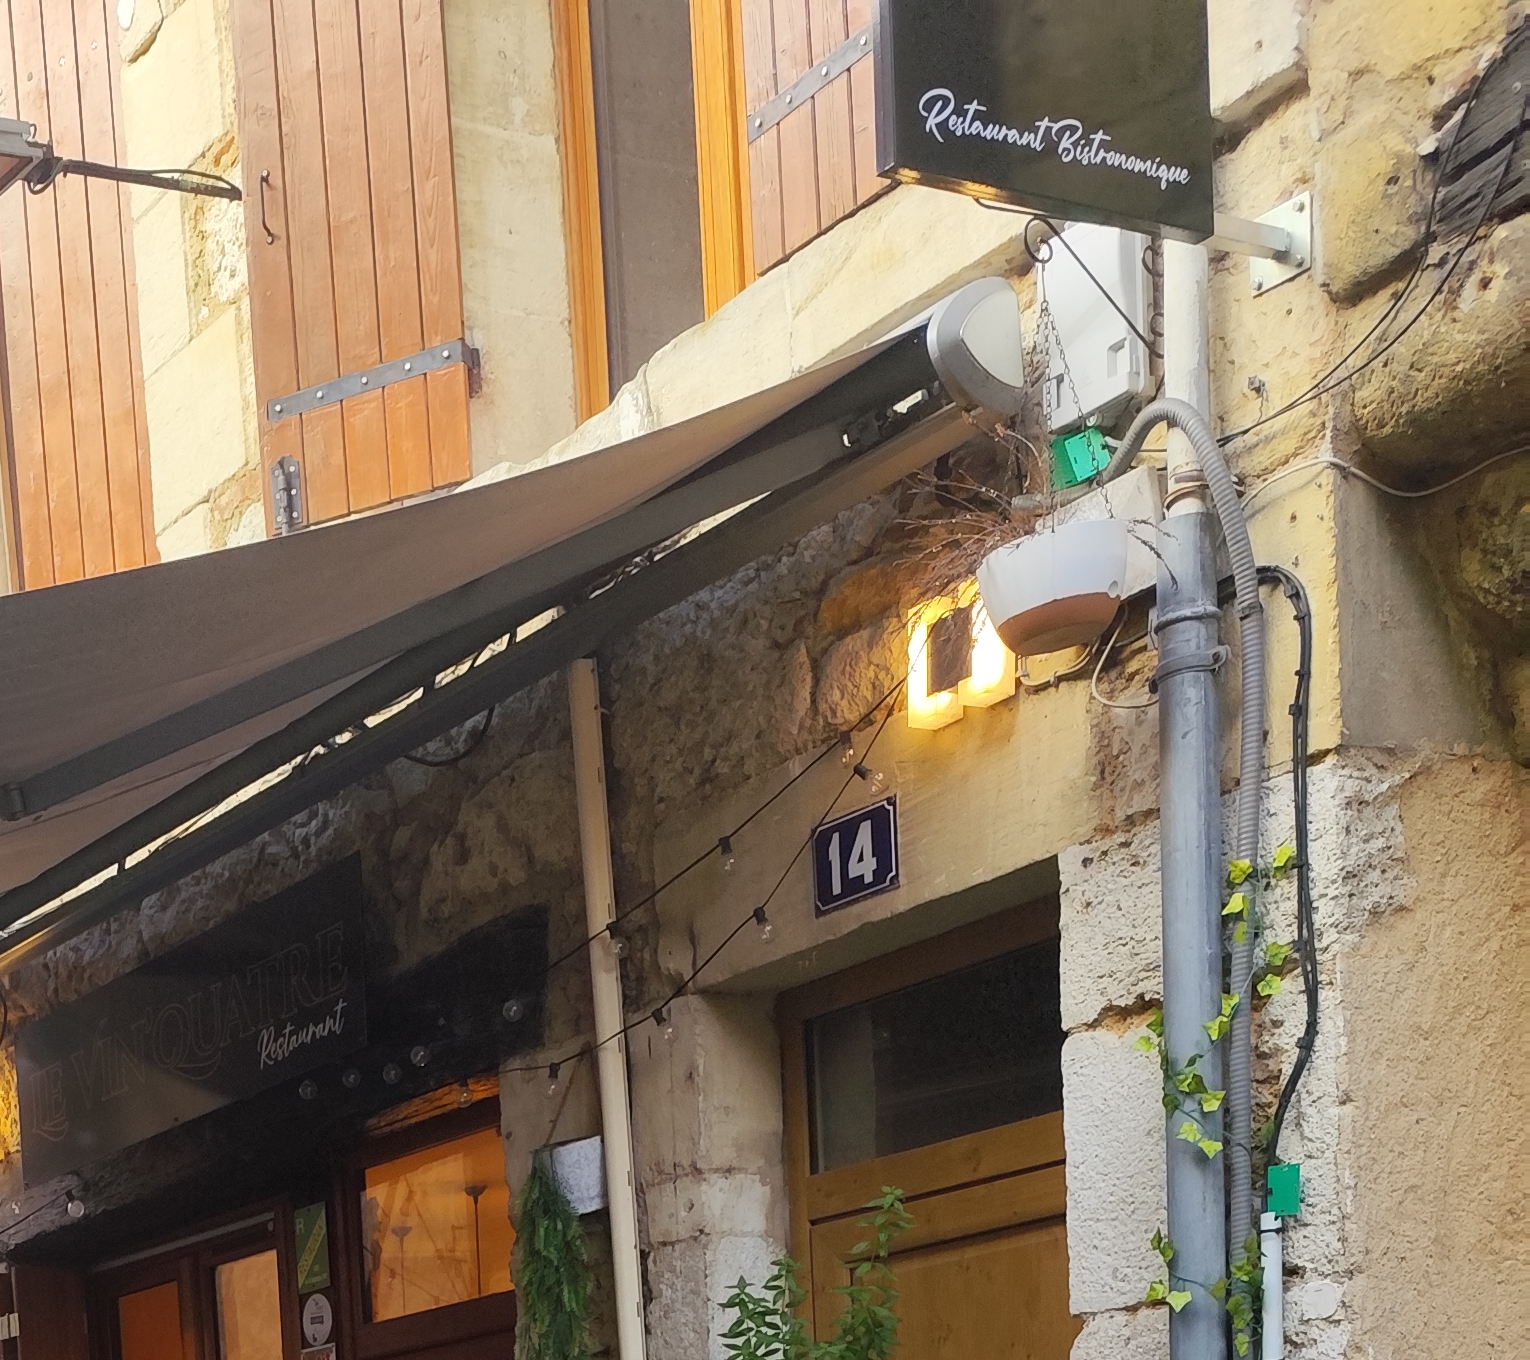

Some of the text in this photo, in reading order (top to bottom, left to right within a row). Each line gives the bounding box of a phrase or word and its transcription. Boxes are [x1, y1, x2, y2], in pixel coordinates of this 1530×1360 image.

[919, 87, 1191, 190] Restaurant Bistronomique
[828, 819, 877, 896] 14
[256, 998, 348, 1070] Restaurant
